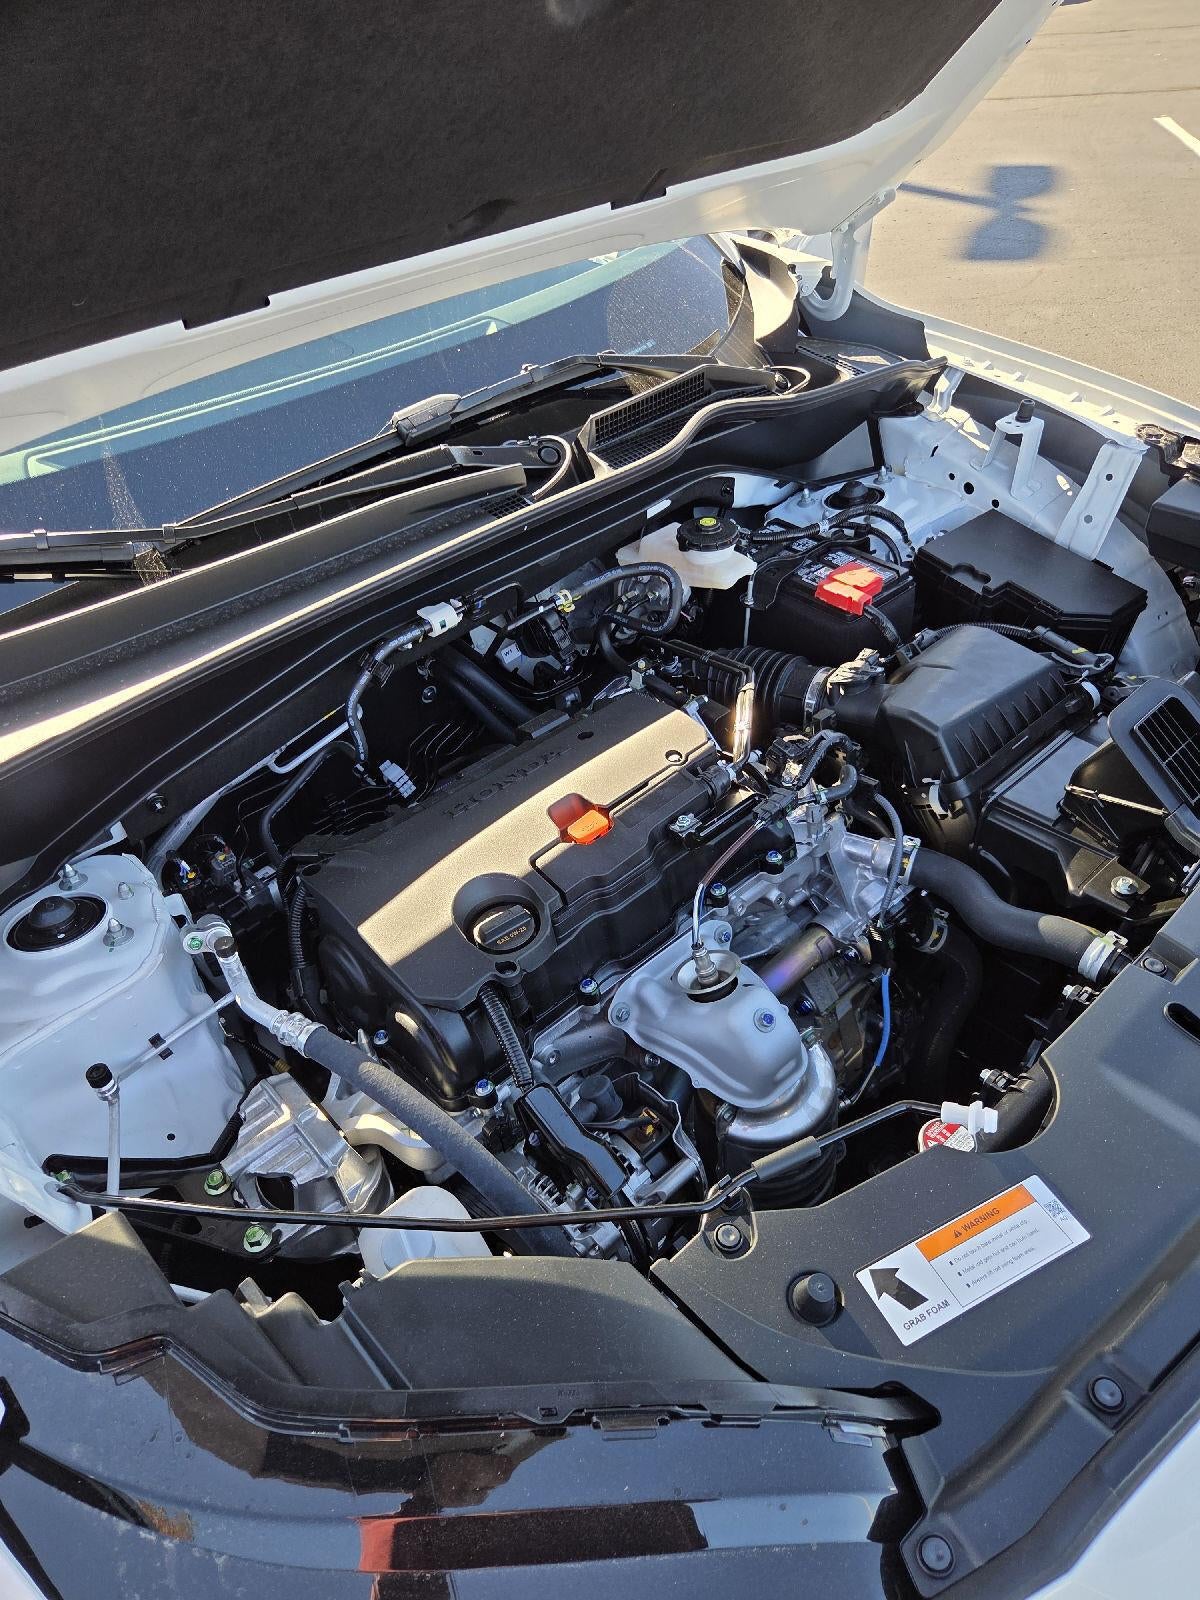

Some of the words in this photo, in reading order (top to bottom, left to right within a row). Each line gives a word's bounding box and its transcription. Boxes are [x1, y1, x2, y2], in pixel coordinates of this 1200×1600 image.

[961, 1208, 1000, 1232] WARNING
[903, 1313, 927, 1331] GRAB
[926, 1299, 950, 1317] FOAM
